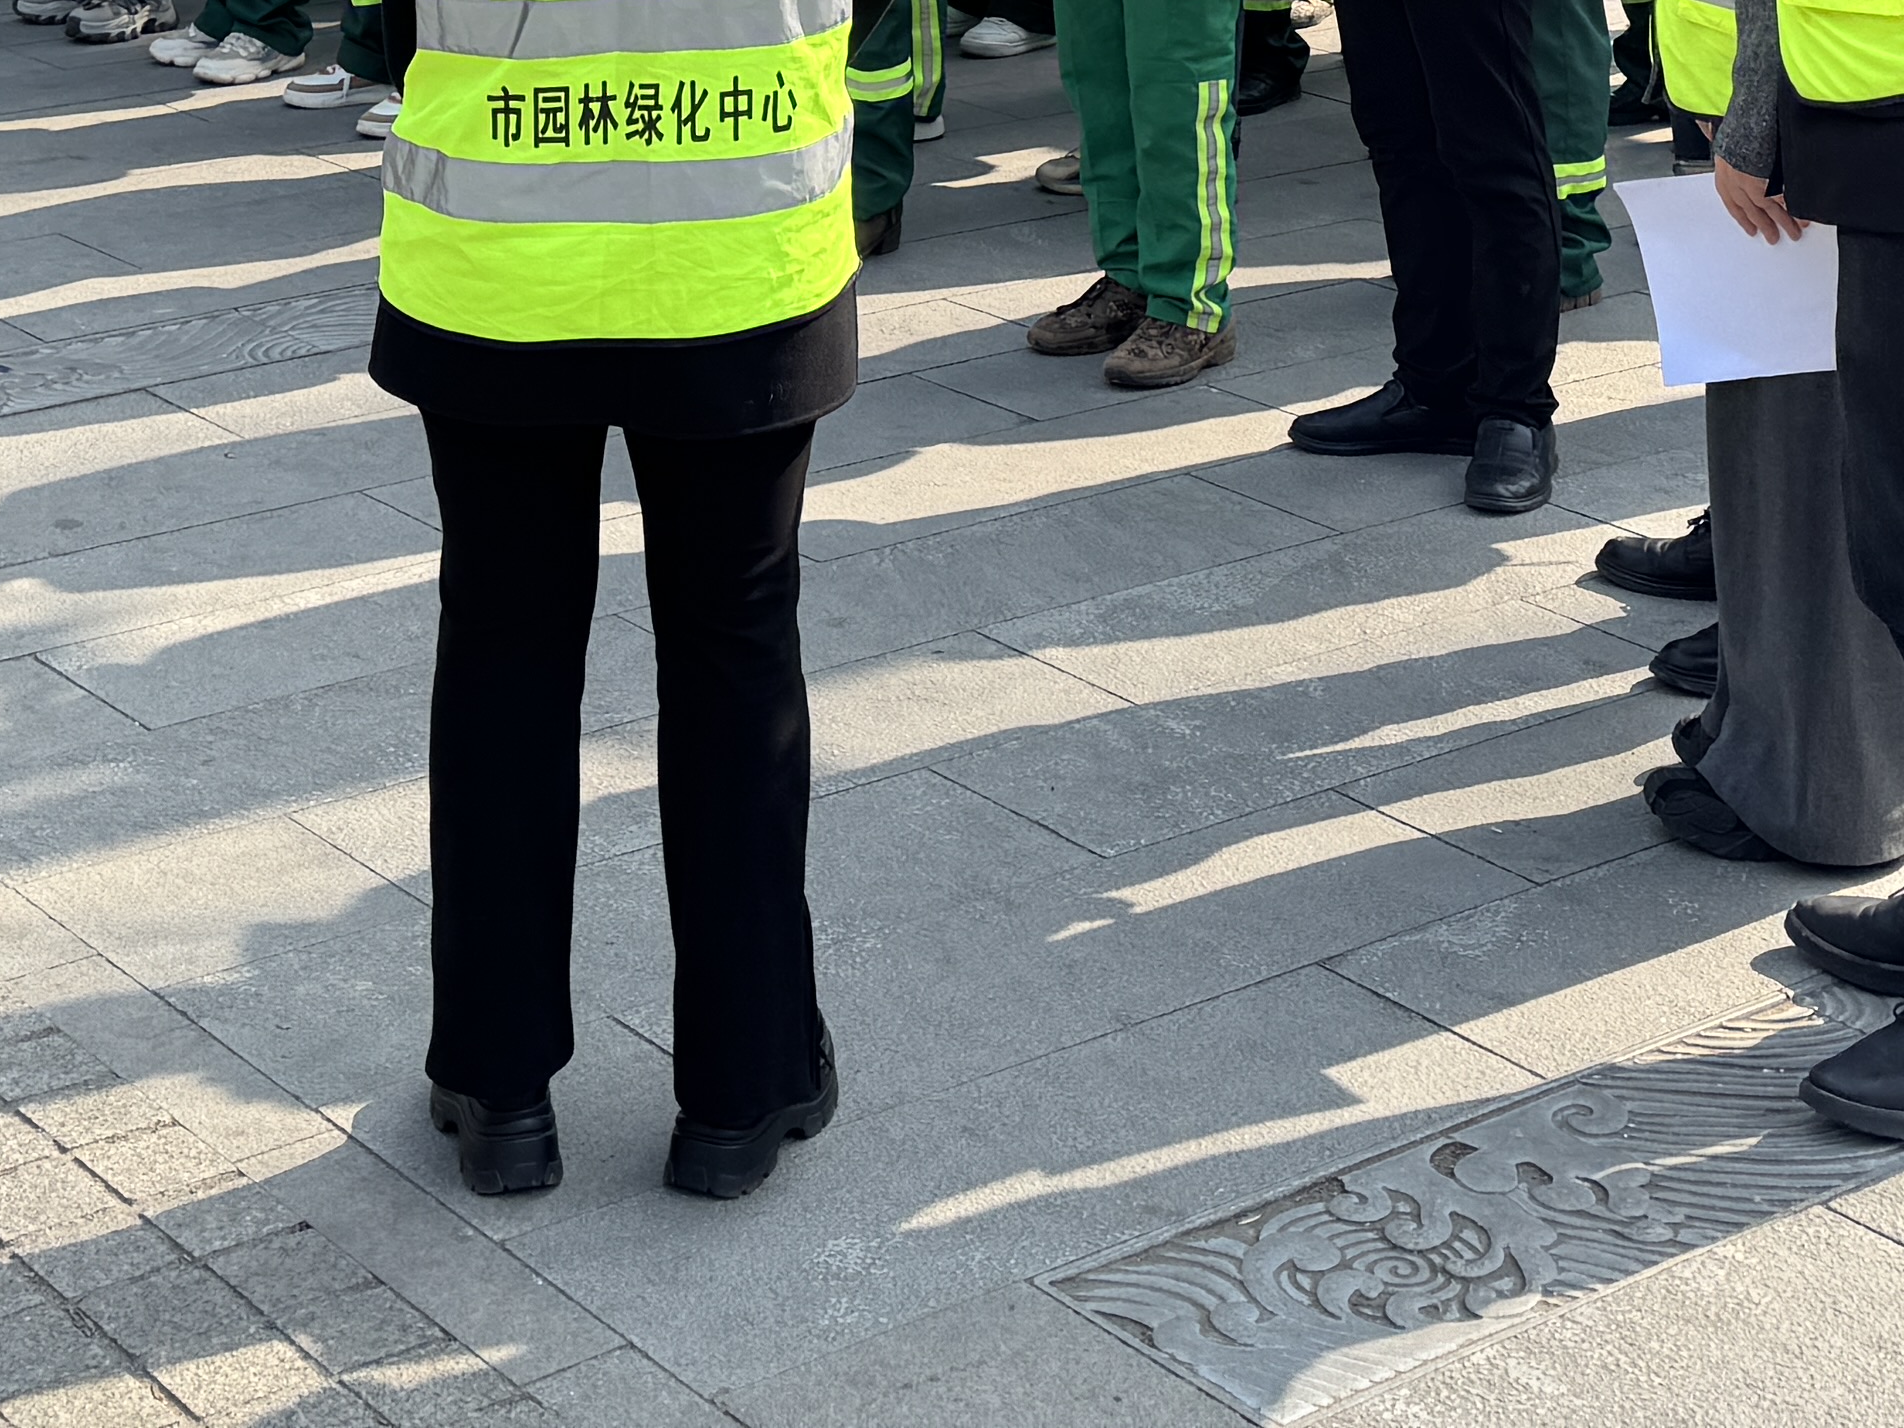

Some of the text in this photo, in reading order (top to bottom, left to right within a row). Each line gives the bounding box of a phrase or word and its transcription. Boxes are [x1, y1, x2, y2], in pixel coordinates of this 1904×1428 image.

[486, 71, 798, 149] 市园林绿化中心
